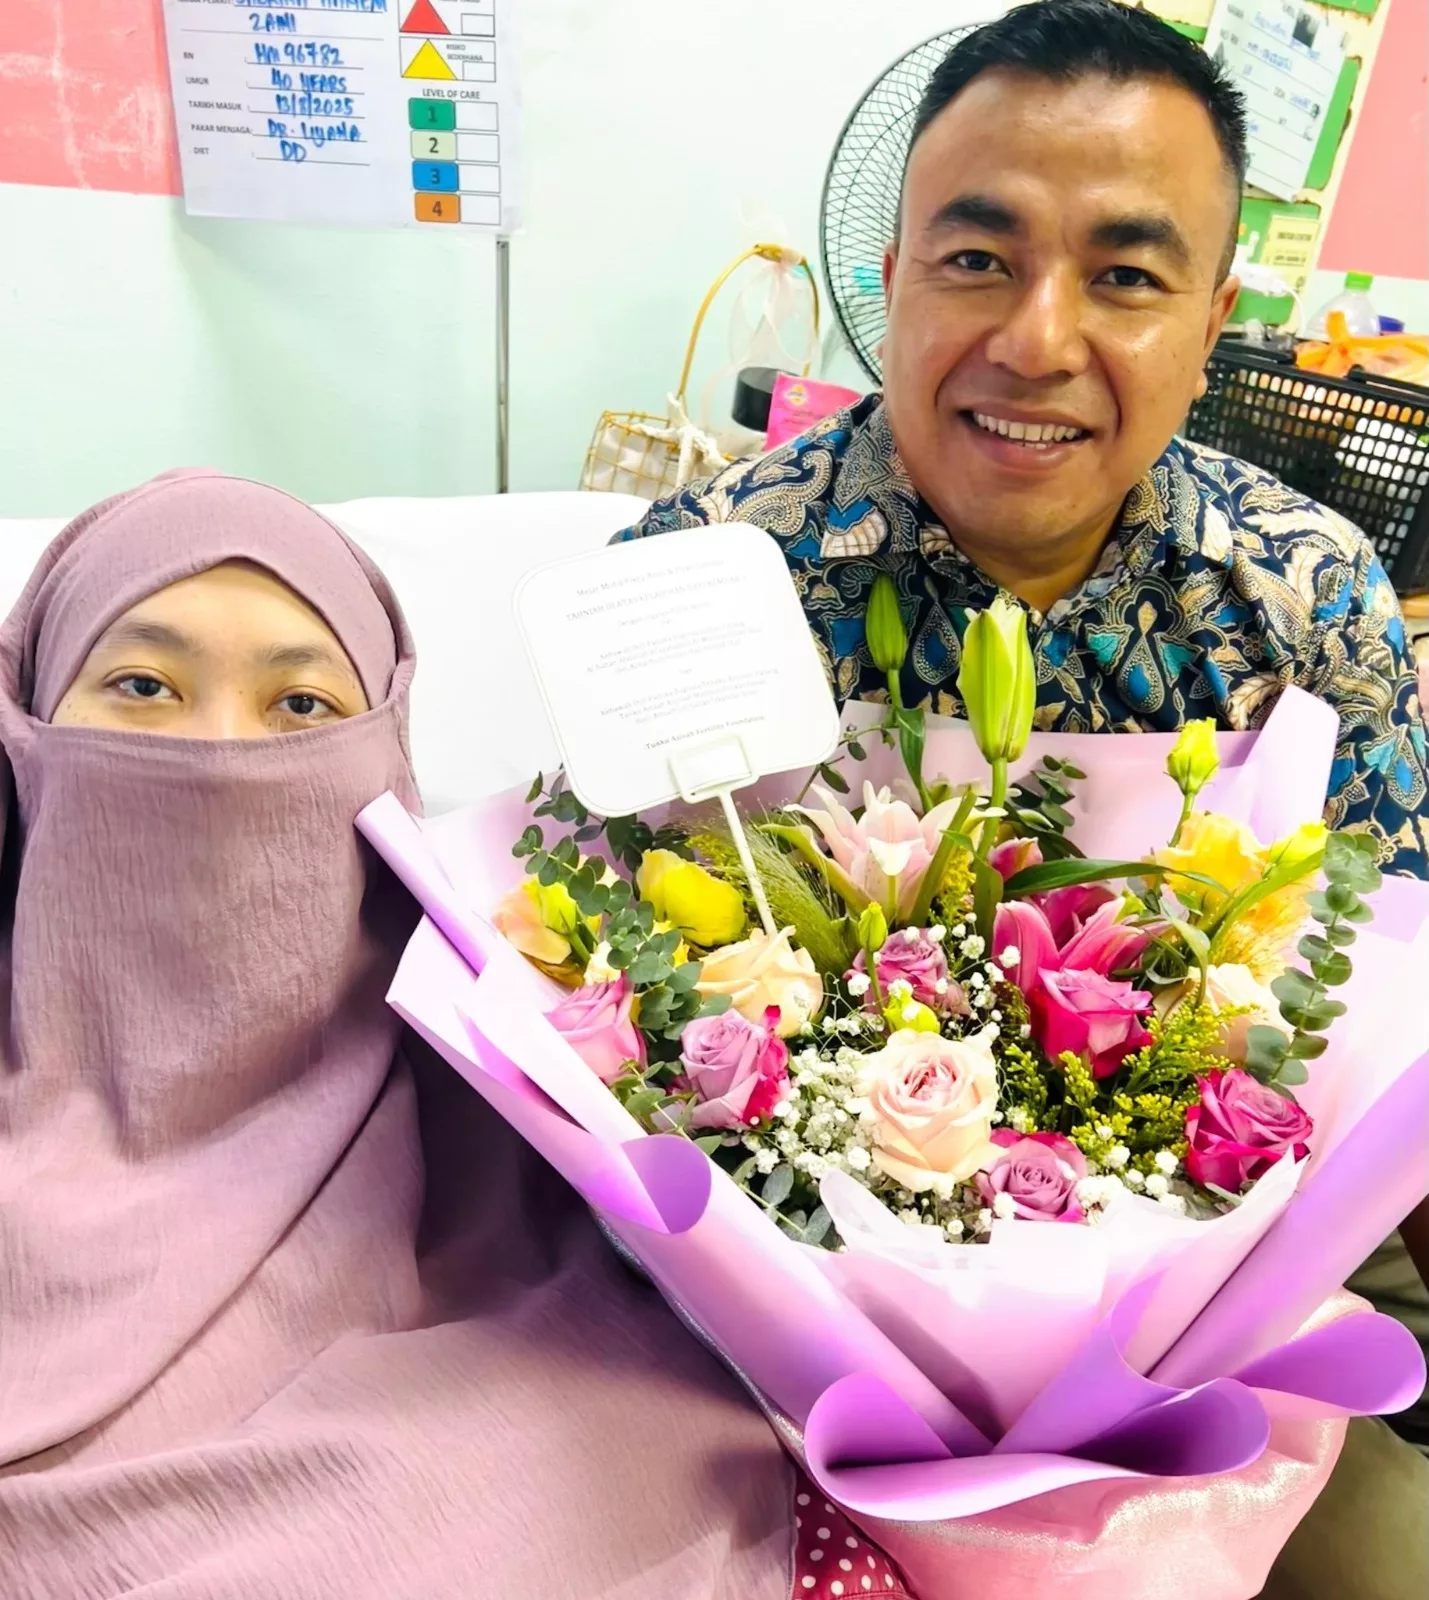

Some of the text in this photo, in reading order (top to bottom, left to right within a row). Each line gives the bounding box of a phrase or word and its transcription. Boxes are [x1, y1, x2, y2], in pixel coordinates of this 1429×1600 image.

[186, 77, 209, 85] UMUR
[423, 89, 480, 99] LEVEL OF CARE
[216, 102, 241, 110] MASUK
[427, 106, 437, 123] 1
[191, 124, 215, 133] PAKAR
[428, 137, 439, 153] 2
[194, 147, 209, 155] DIET
[431, 168, 440, 184] 3
[432, 201, 442, 217] 4
